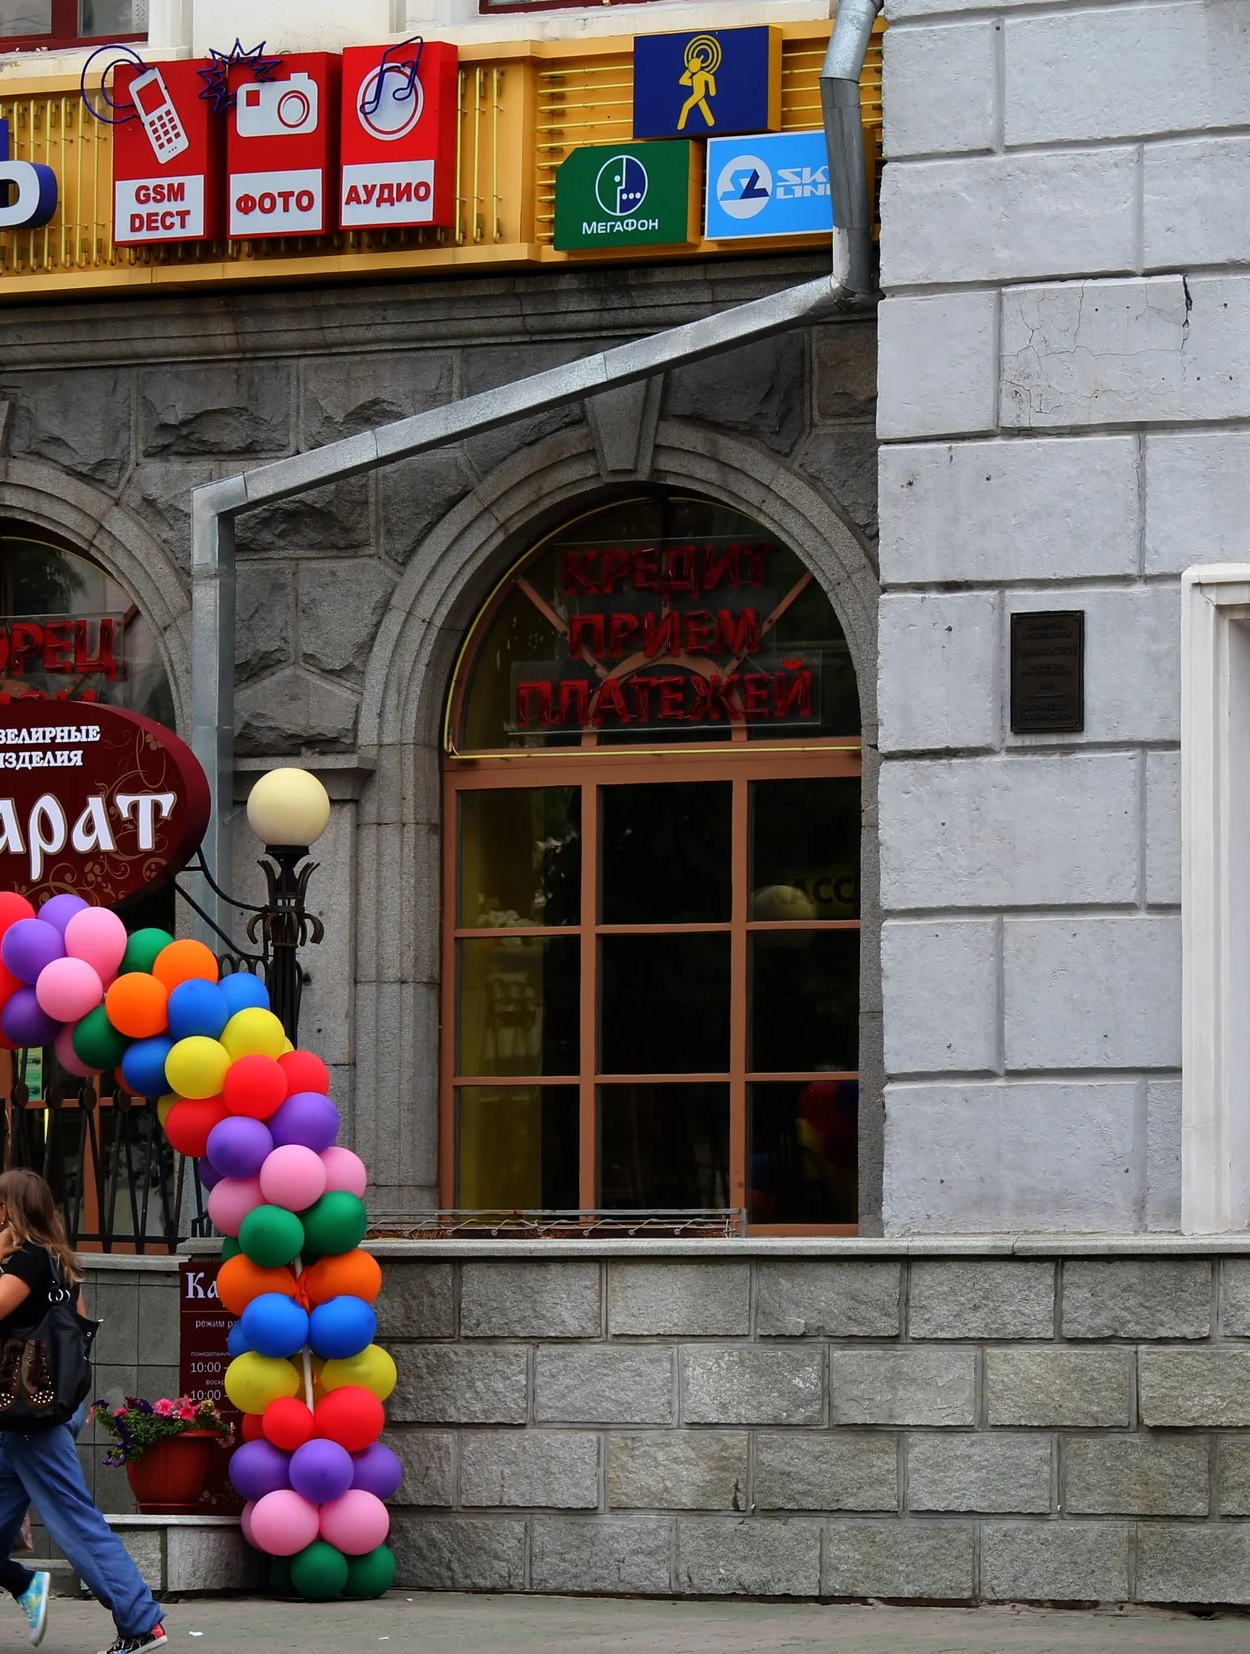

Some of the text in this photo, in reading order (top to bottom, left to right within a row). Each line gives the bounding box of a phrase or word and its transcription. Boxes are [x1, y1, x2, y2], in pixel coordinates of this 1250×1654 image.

[134, 182, 185, 205] GSM
[235, 189, 315, 216] ФОТО
[344, 181, 431, 207] АУДИО
[129, 209, 191, 233] DECT
[561, 542, 770, 597] КРЕДИТ
[568, 608, 761, 661] ПРИЕМ
[515, 657, 812, 727] ПЛАТЕЖЕЙ
[185, 1272, 219, 1298] Ка
[195, 1320, 225, 1329] режим
[190, 1362, 222, 1373] 10:00
[190, 1390, 222, 1401] 10:00
